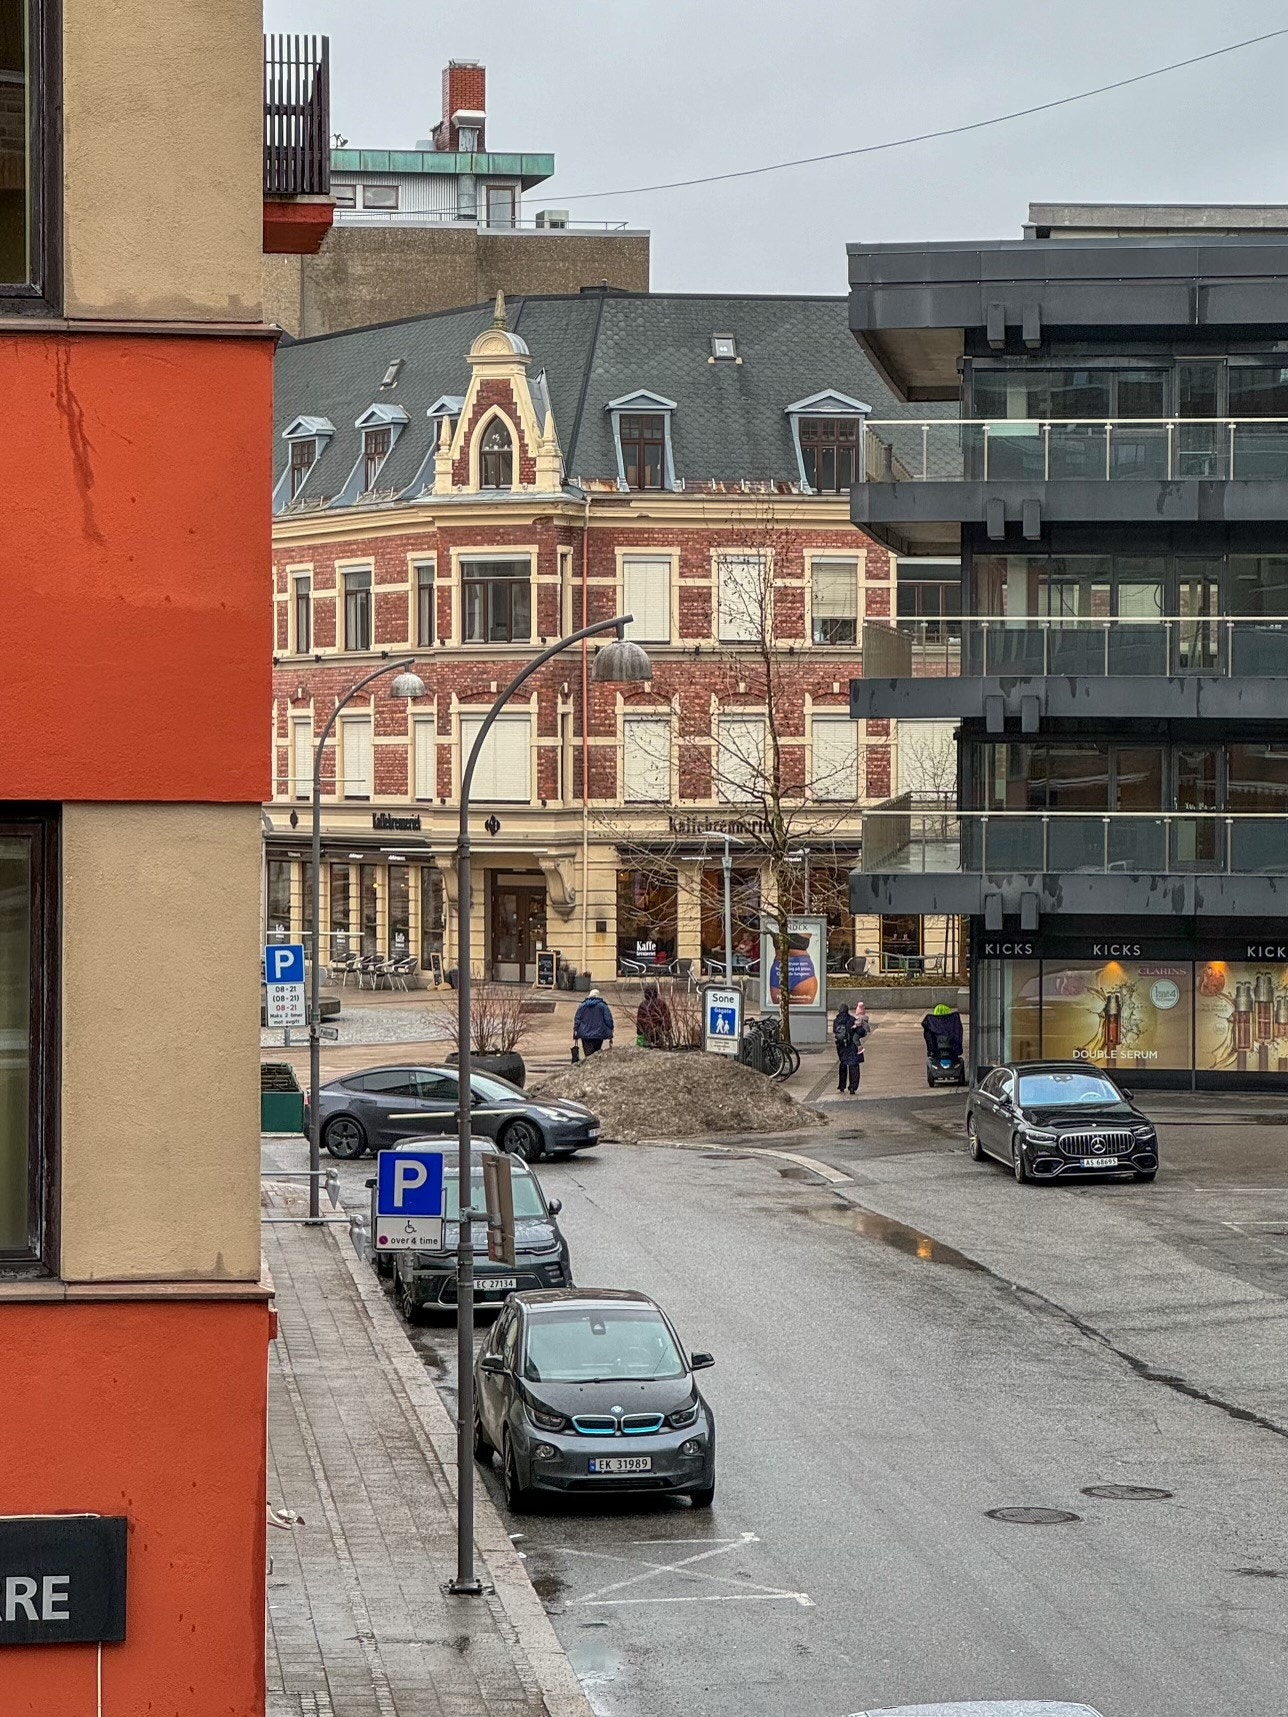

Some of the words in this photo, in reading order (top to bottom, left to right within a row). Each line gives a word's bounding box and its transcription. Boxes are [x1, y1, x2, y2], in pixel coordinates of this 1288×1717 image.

[636, 941, 657, 951] Kaffe
[985, 944, 1033, 955] KICKS
[1093, 945, 1141, 956] KICKS
[275, 950, 294, 979] P
[1138, 968, 1187, 976] CLARINS
[712, 993, 734, 1004] Sone
[1072, 1050, 1117, 1059] DOUBLE
[1120, 1050, 1158, 1059] SERUM
[394, 1160, 427, 1207] P
[490, 1280, 513, 1288] 27134
[600, 1460, 611, 1469] EK
[616, 1459, 648, 1469] 31989
